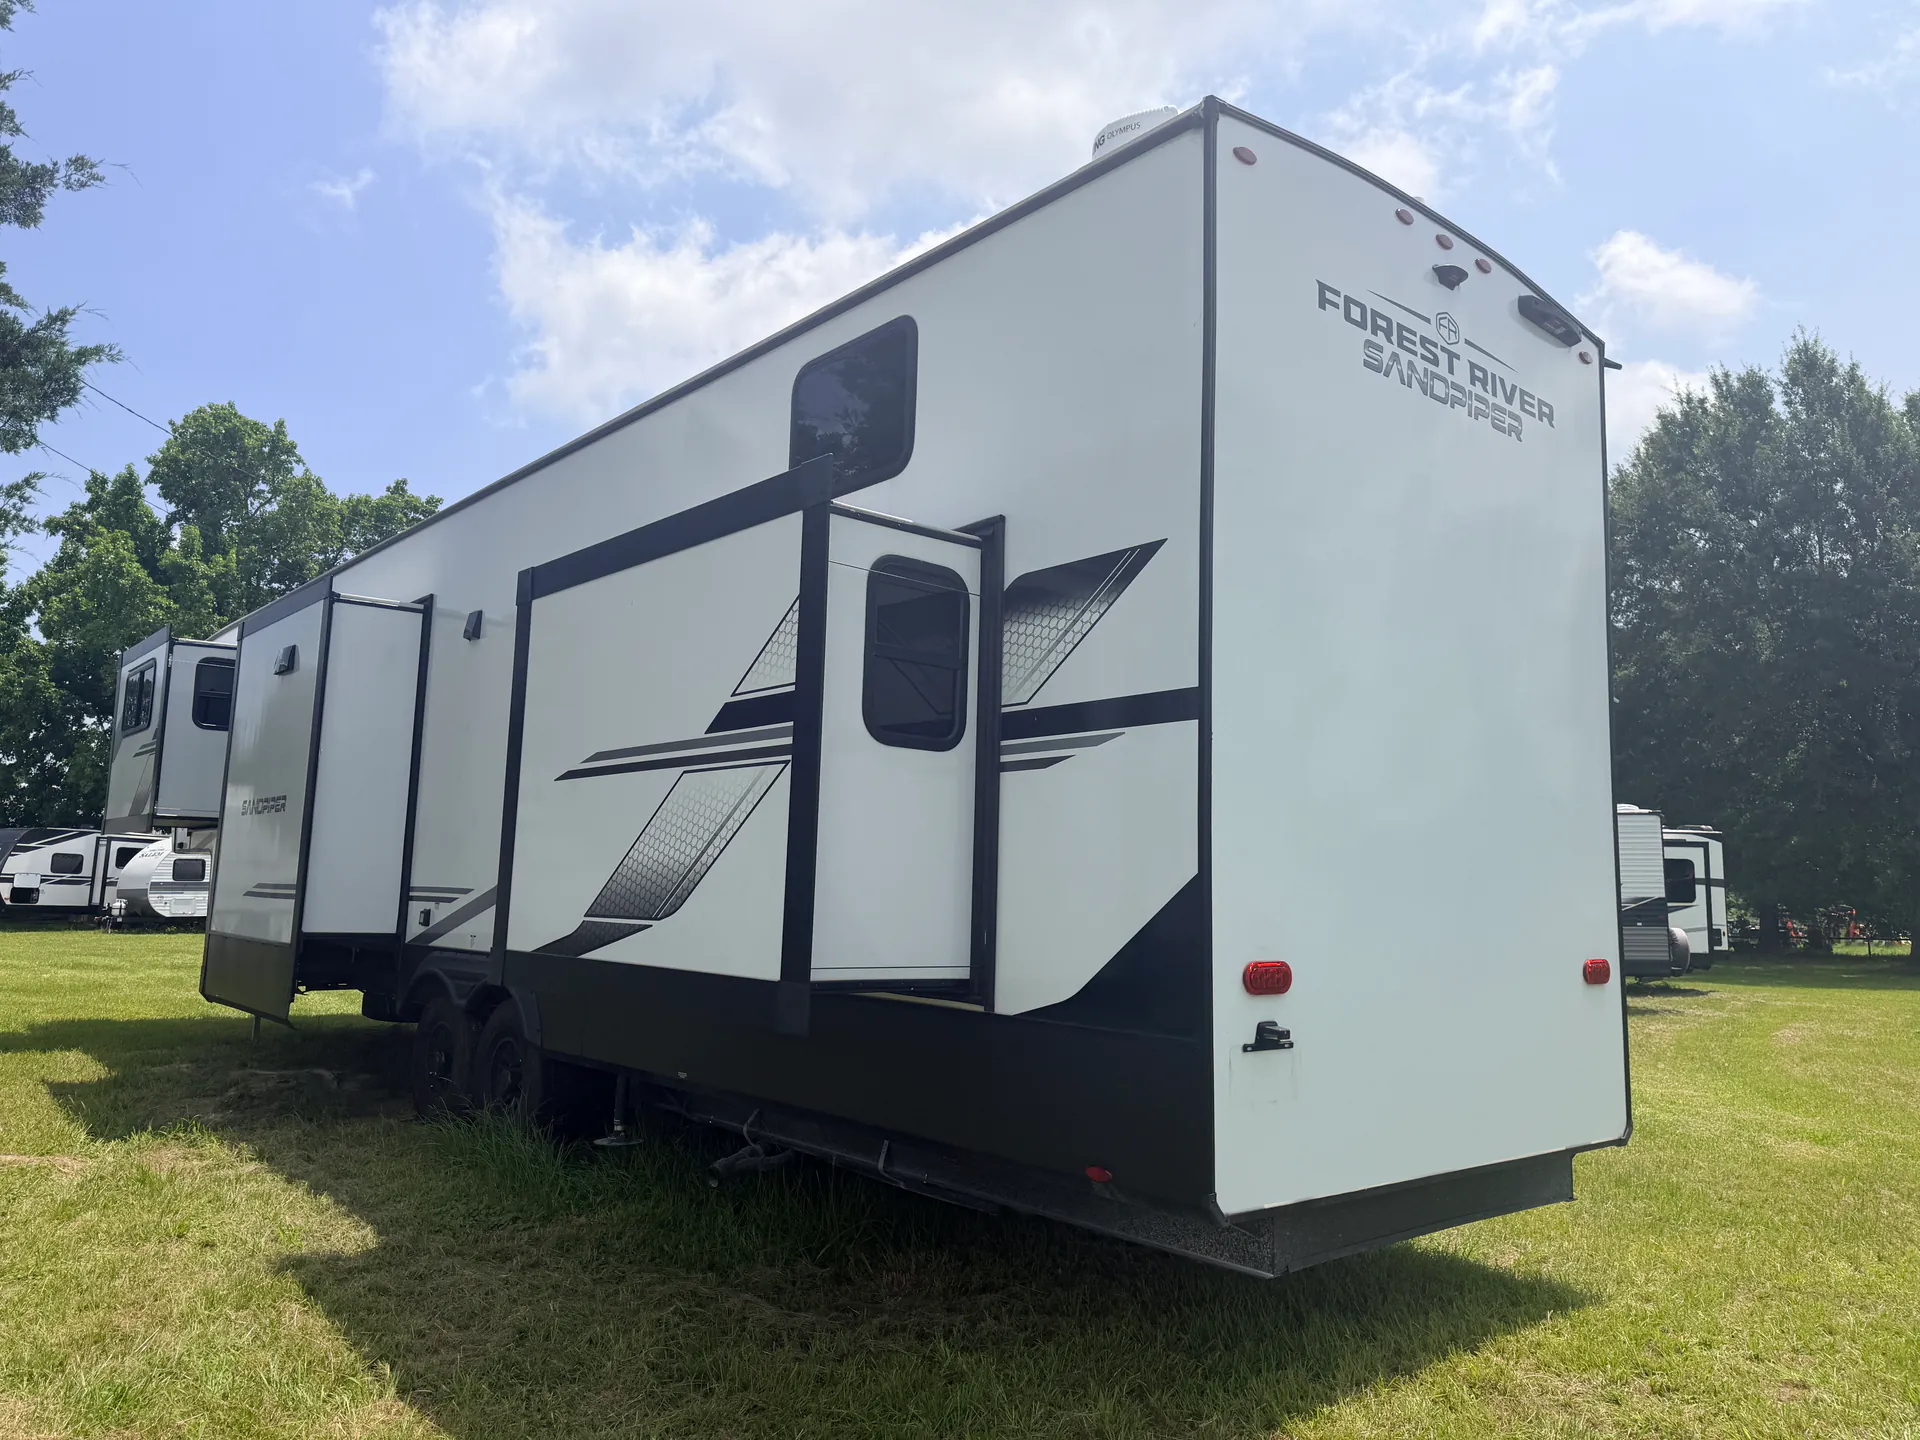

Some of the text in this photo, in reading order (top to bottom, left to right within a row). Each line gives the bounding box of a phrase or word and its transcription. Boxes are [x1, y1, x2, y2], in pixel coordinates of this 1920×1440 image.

[1107, 121, 1141, 140] OLYMPUS
[1316, 279, 1555, 429] FOREST RIVER
[1363, 338, 1523, 442] SANDPIPER
[241, 795, 287, 816] SANDPIPER
